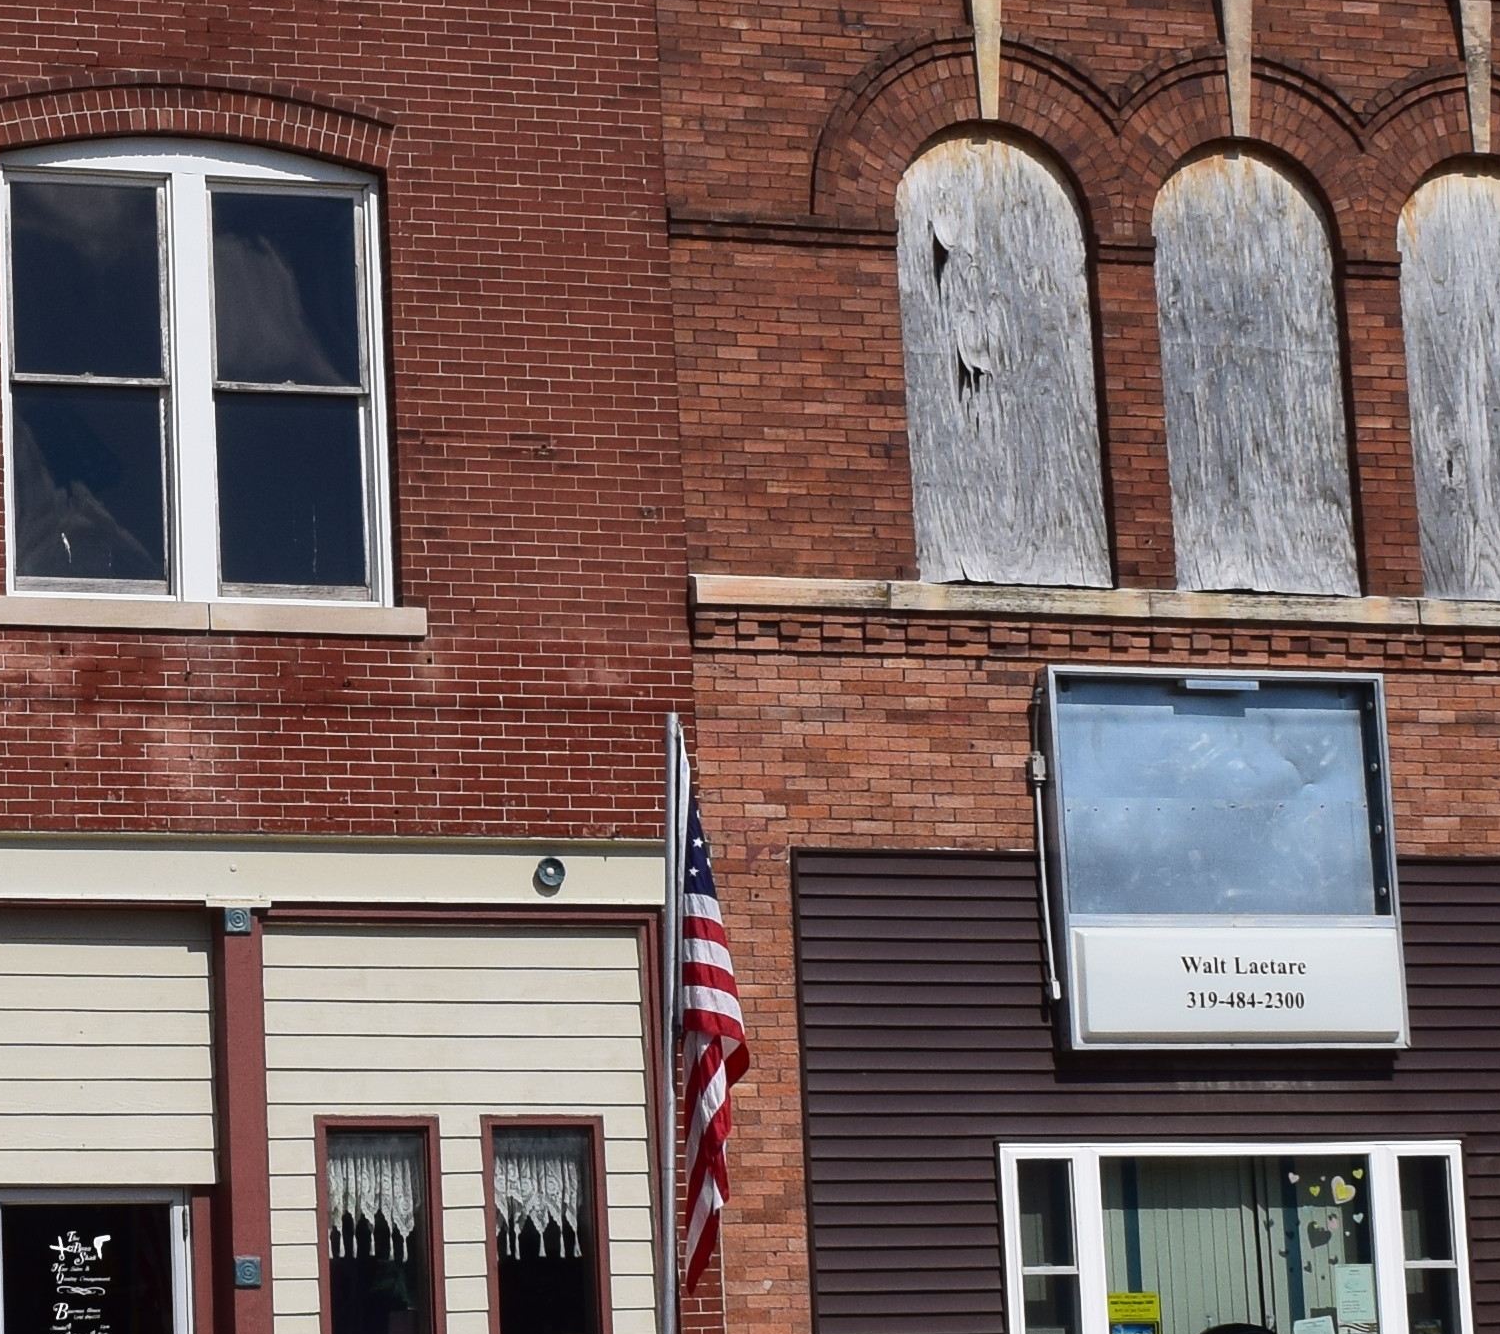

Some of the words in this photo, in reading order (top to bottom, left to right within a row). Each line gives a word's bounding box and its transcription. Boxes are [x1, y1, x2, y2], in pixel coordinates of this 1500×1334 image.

[1180, 956, 1227, 975] Walt
[1234, 956, 1308, 976] Laetare
[1185, 991, 1306, 1010] 319-484-2300
